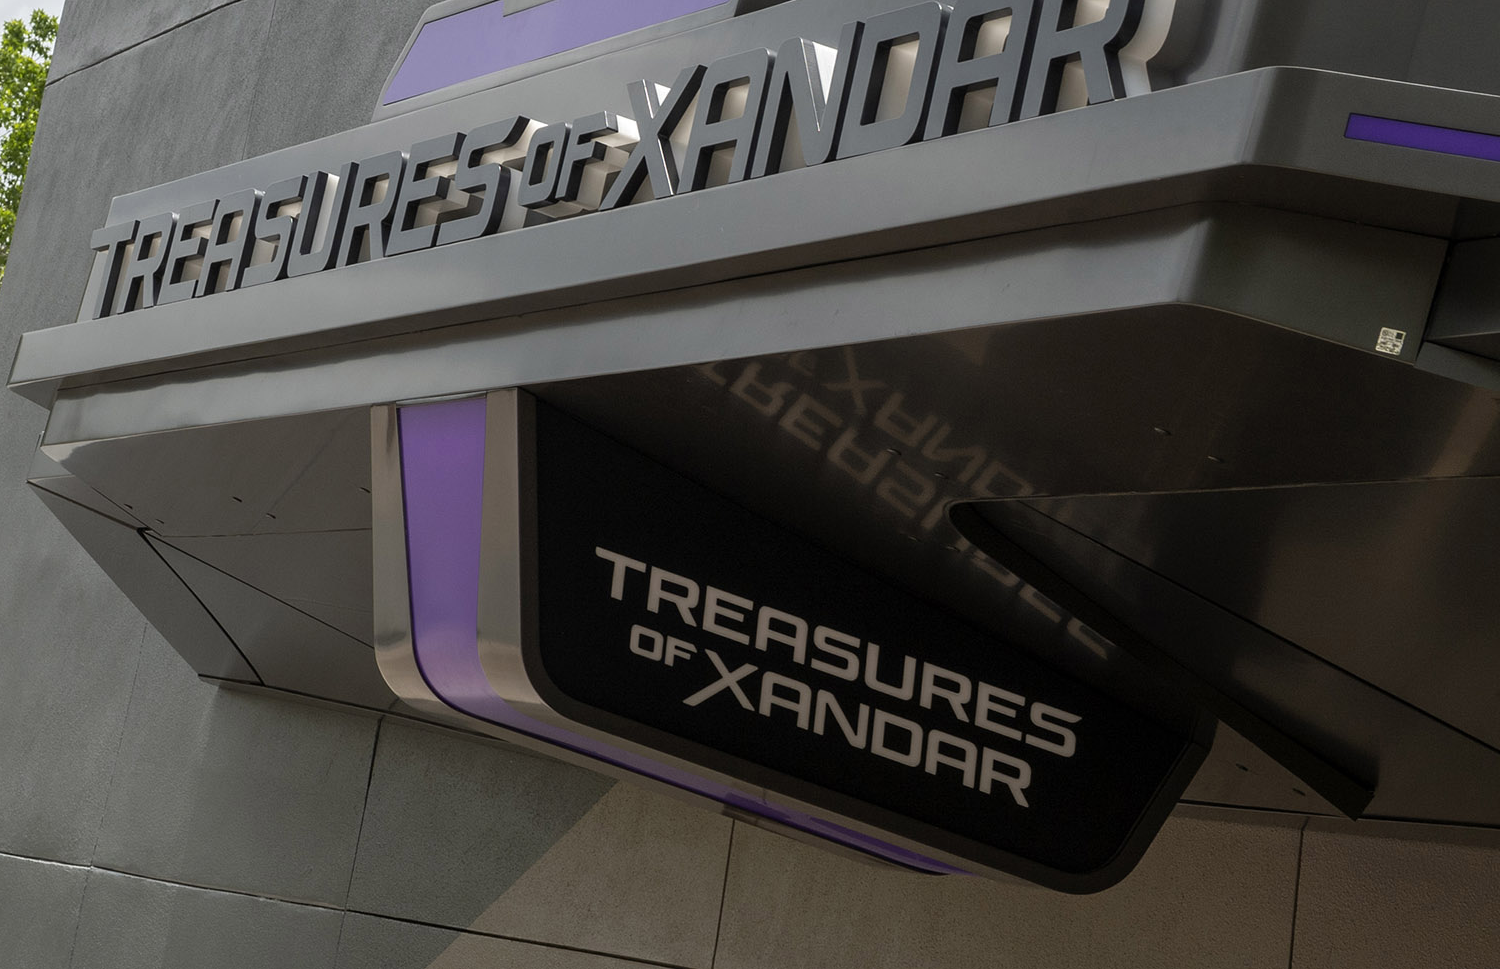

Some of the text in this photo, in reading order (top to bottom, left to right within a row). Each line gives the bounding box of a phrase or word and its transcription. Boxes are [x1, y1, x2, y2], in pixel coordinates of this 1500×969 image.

[91, 114, 530, 320] TREASURES
[518, 110, 618, 209] OF
[595, 546, 1082, 758] TREASURES
[629, 624, 1033, 809] OF XANDAR
